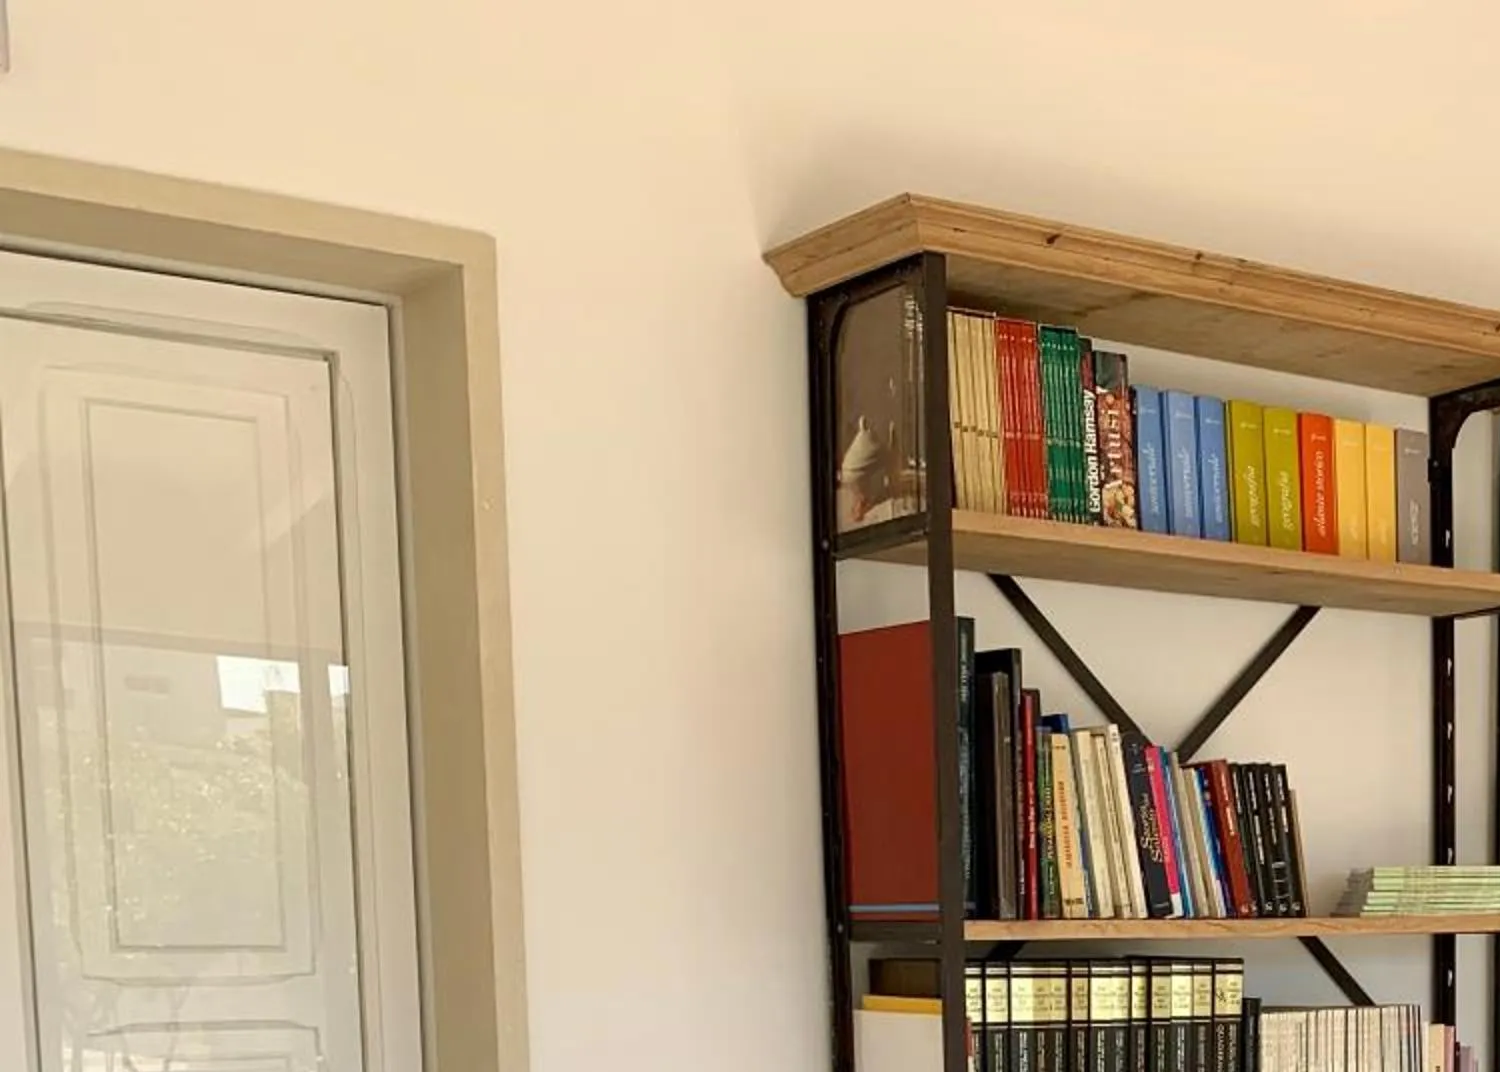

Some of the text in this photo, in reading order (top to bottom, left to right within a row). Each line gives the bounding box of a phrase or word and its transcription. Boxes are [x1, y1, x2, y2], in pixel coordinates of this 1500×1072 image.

[1083, 389, 1101, 513] Gordon Ramsay
[1102, 408, 1123, 489] Artusi
